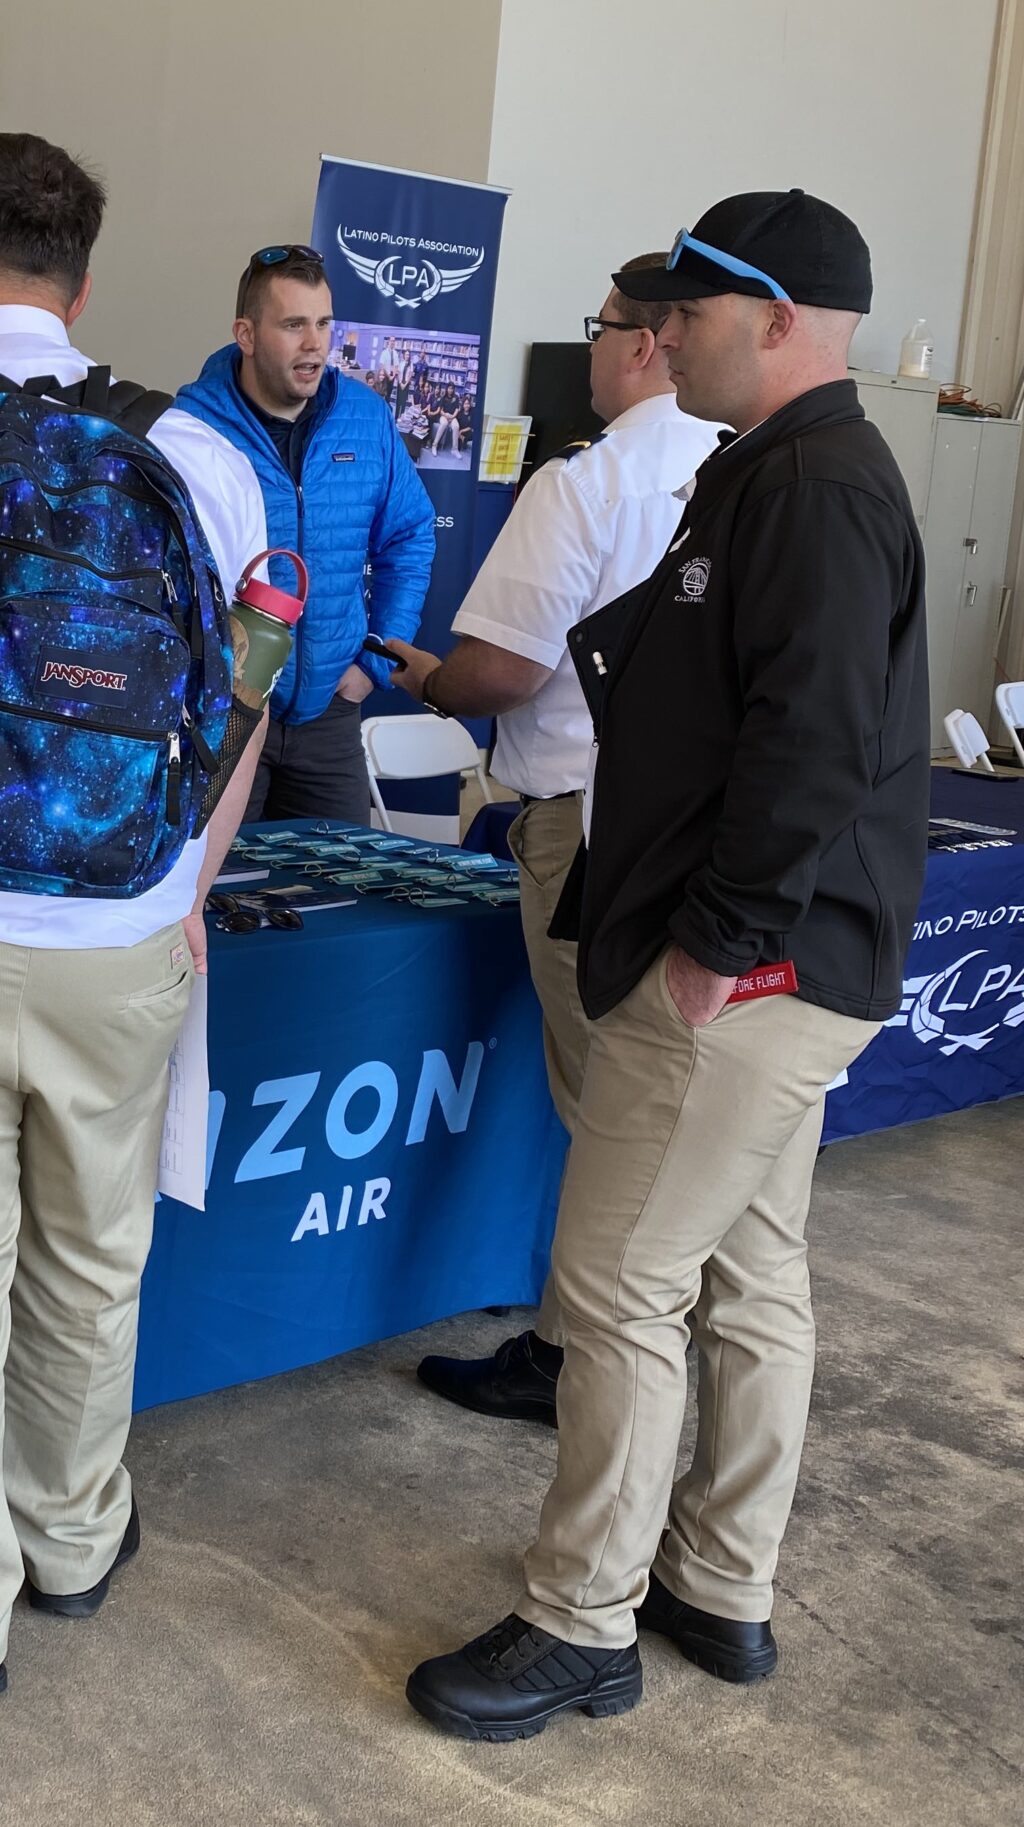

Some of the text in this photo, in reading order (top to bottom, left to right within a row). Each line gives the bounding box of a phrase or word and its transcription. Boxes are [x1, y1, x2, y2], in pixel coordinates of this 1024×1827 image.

[388, 263, 430, 288] LPA
[40, 661, 127, 691] JANSPORT
[756, 971, 786, 990] FLIGHT
[291, 1176, 392, 1243] AIR
